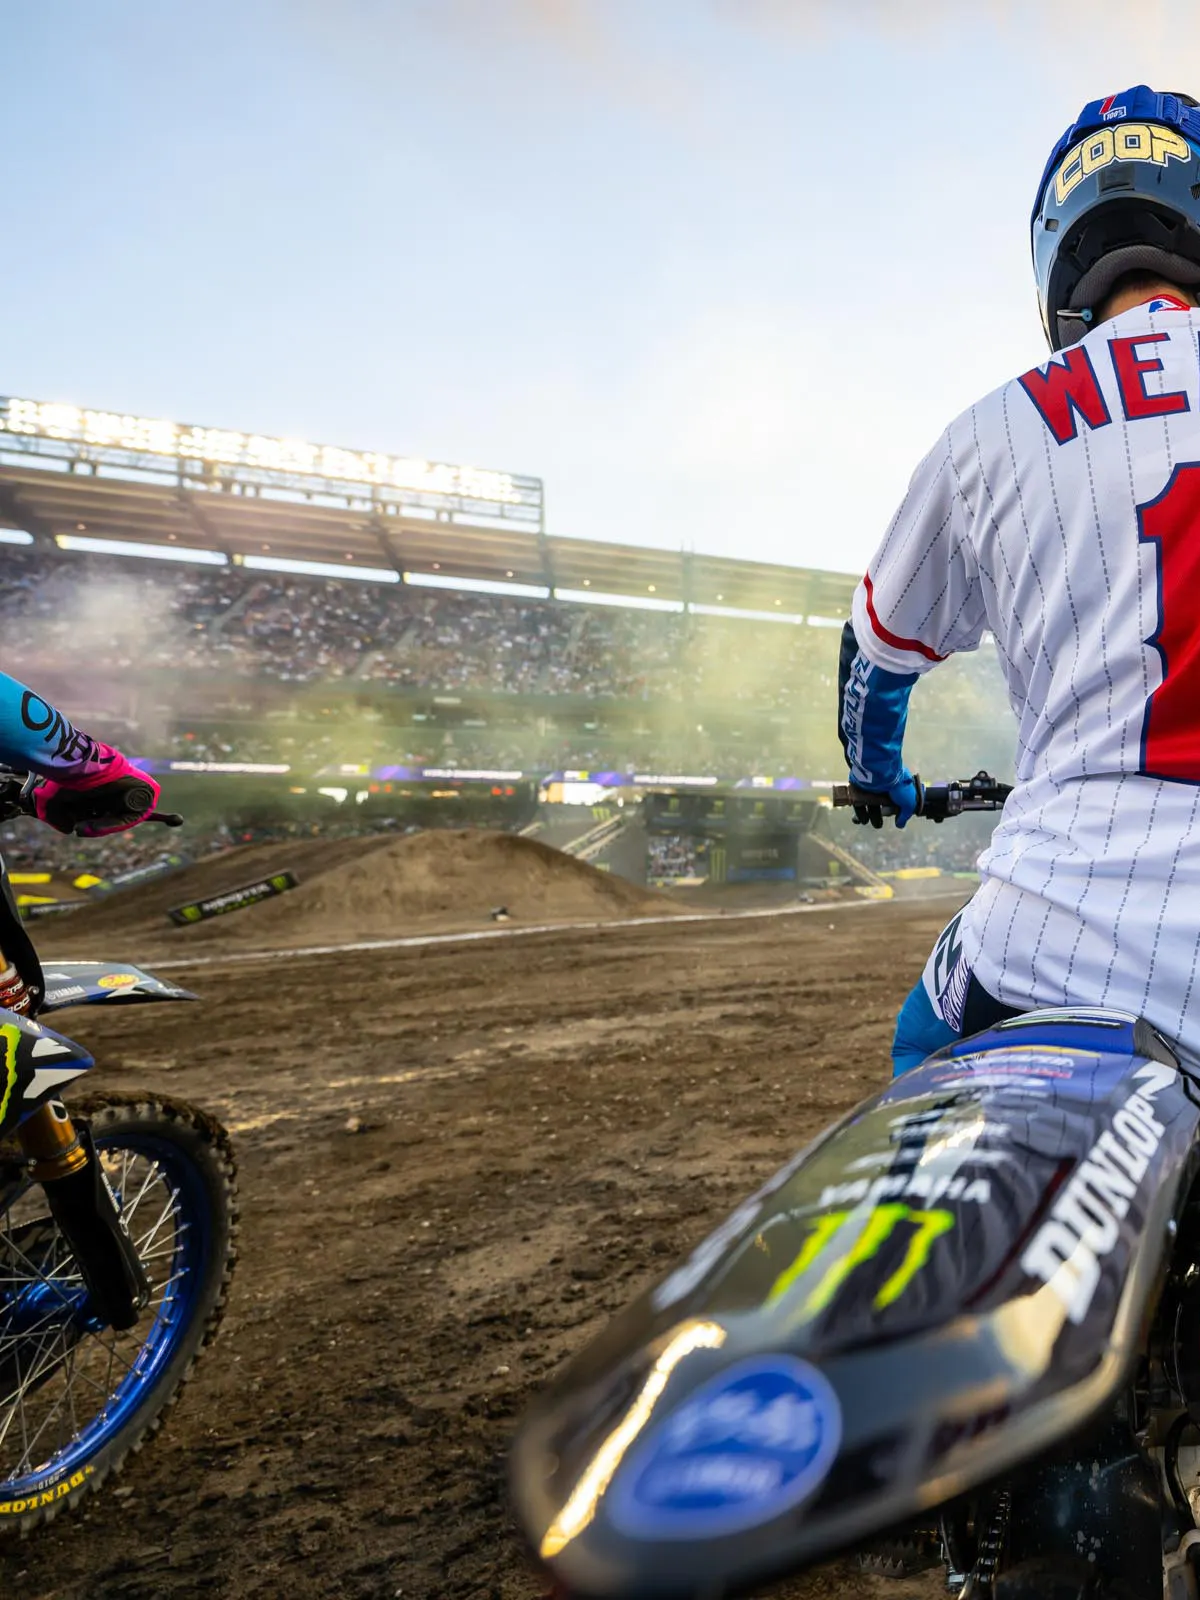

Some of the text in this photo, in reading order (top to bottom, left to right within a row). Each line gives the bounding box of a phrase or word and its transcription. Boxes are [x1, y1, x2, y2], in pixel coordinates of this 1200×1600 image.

[1056, 122, 1191, 206] COOP
[817, 1173, 992, 1207] YAMAHA
[1021, 1092, 1166, 1324] DUNLOP
[0, 1471, 85, 1513] DUNLOP
